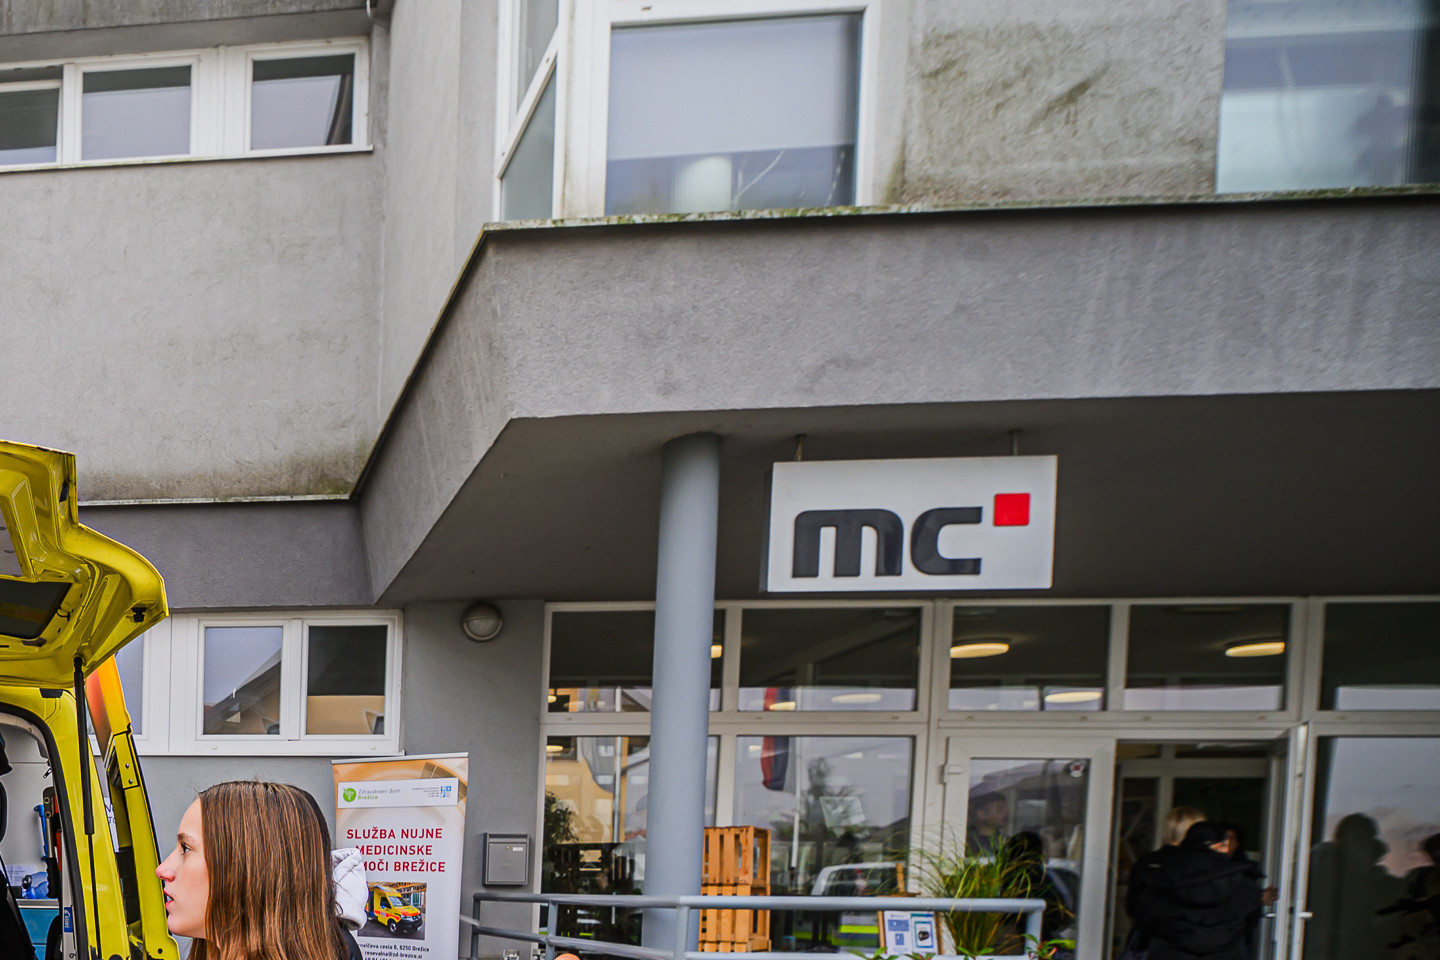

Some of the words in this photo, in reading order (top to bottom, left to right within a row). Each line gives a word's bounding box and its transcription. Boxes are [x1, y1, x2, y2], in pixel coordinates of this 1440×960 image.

[791, 506, 983, 578] mc
[346, 826, 396, 839] SLUŽBA
[401, 828, 443, 839] NUJNE
[355, 845, 433, 855] MEDICINSKE
[363, 859, 389, 872] OČI
[393, 859, 446, 872] BREŽICE
